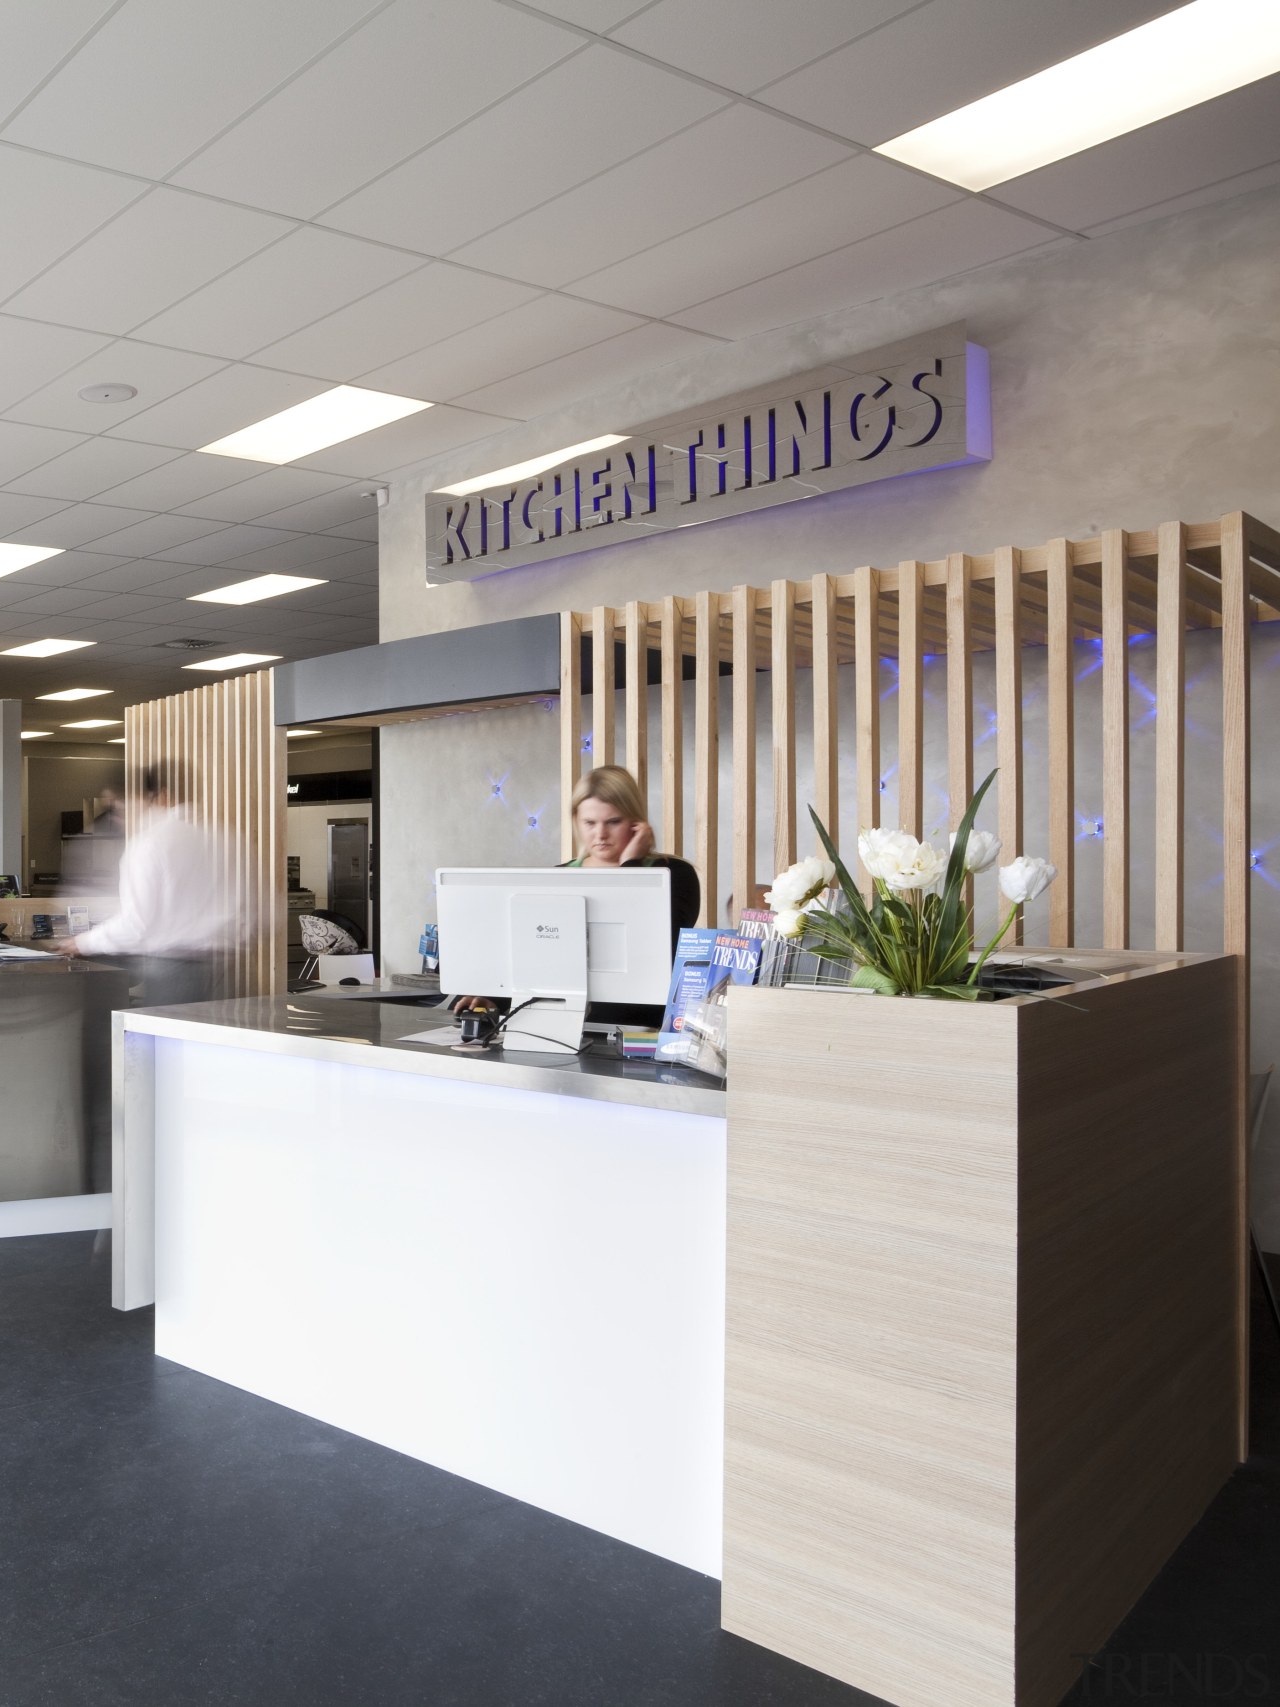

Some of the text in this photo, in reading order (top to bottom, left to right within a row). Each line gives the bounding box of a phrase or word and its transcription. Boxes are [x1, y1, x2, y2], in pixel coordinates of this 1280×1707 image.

[441, 358, 944, 566] KITCHEN THINGS
[757, 912, 775, 922] HOM
[544, 925, 559, 933] Sun
[738, 920, 778, 941] TREN
[716, 935, 750, 949] NEW HOME
[713, 946, 759, 972] TRENDS
